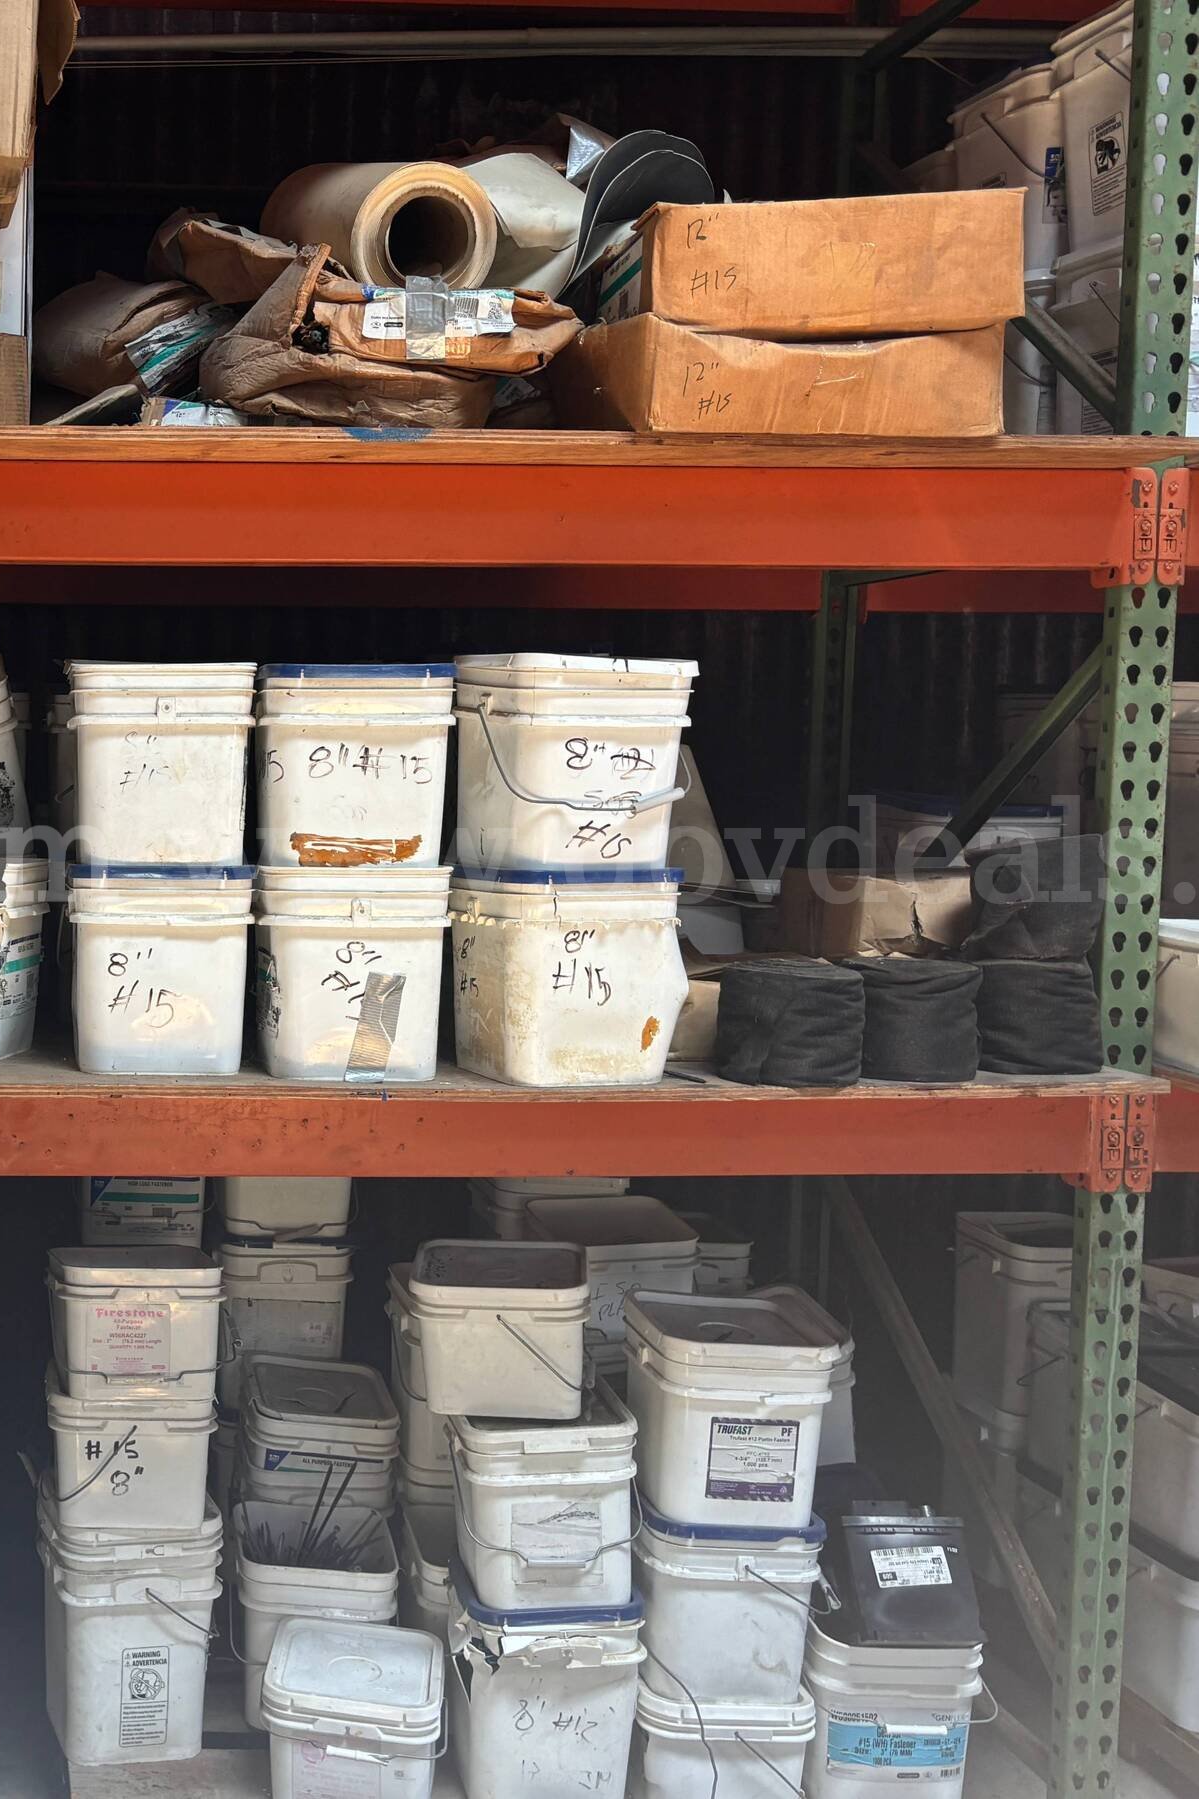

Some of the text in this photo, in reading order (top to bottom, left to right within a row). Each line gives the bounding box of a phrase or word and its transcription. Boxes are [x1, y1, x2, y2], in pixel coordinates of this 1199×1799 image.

[691, 266, 737, 297] #15
[682, 362, 719, 397] 12"
[698, 390, 732, 420] #15
[309, 742, 349, 779] 8"
[564, 929, 596, 953] 8"
[108, 948, 152, 976] 8"
[552, 958, 611, 1006] #15
[108, 979, 182, 1028] #15
[96, 1308, 164, 1318] Firestone
[717, 1424, 793, 1437] TRUFAST PF
[110, 1466, 144, 1496] 8"
[132, 1650, 161, 1659] WARNING
[132, 1658, 167, 1667] ADVERTENCIA
[858, 1737, 917, 1749] #15 (WH) Fastener
